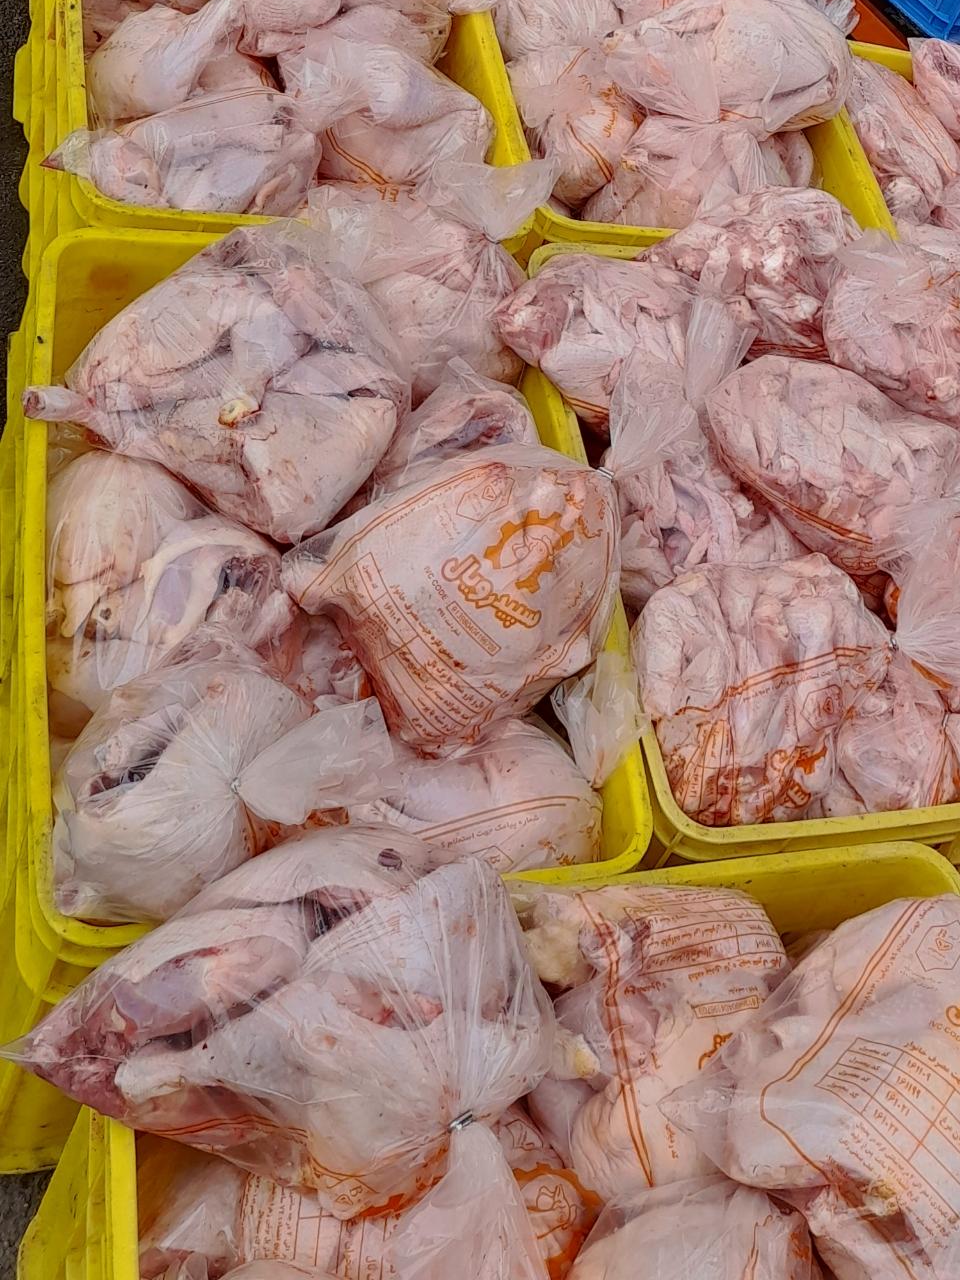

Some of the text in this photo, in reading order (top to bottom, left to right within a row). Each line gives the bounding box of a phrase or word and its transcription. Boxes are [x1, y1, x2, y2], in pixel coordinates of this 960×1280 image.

[389, 581, 409, 603] خانوار
[431, 579, 449, 601] CODE
[402, 600, 422, 622] مصرف
[445, 813, 540, 847] شماره پیامک جهت استعلام
[903, 1038, 927, 1061] خانوار
[926, 1052, 951, 1075] مصرف
